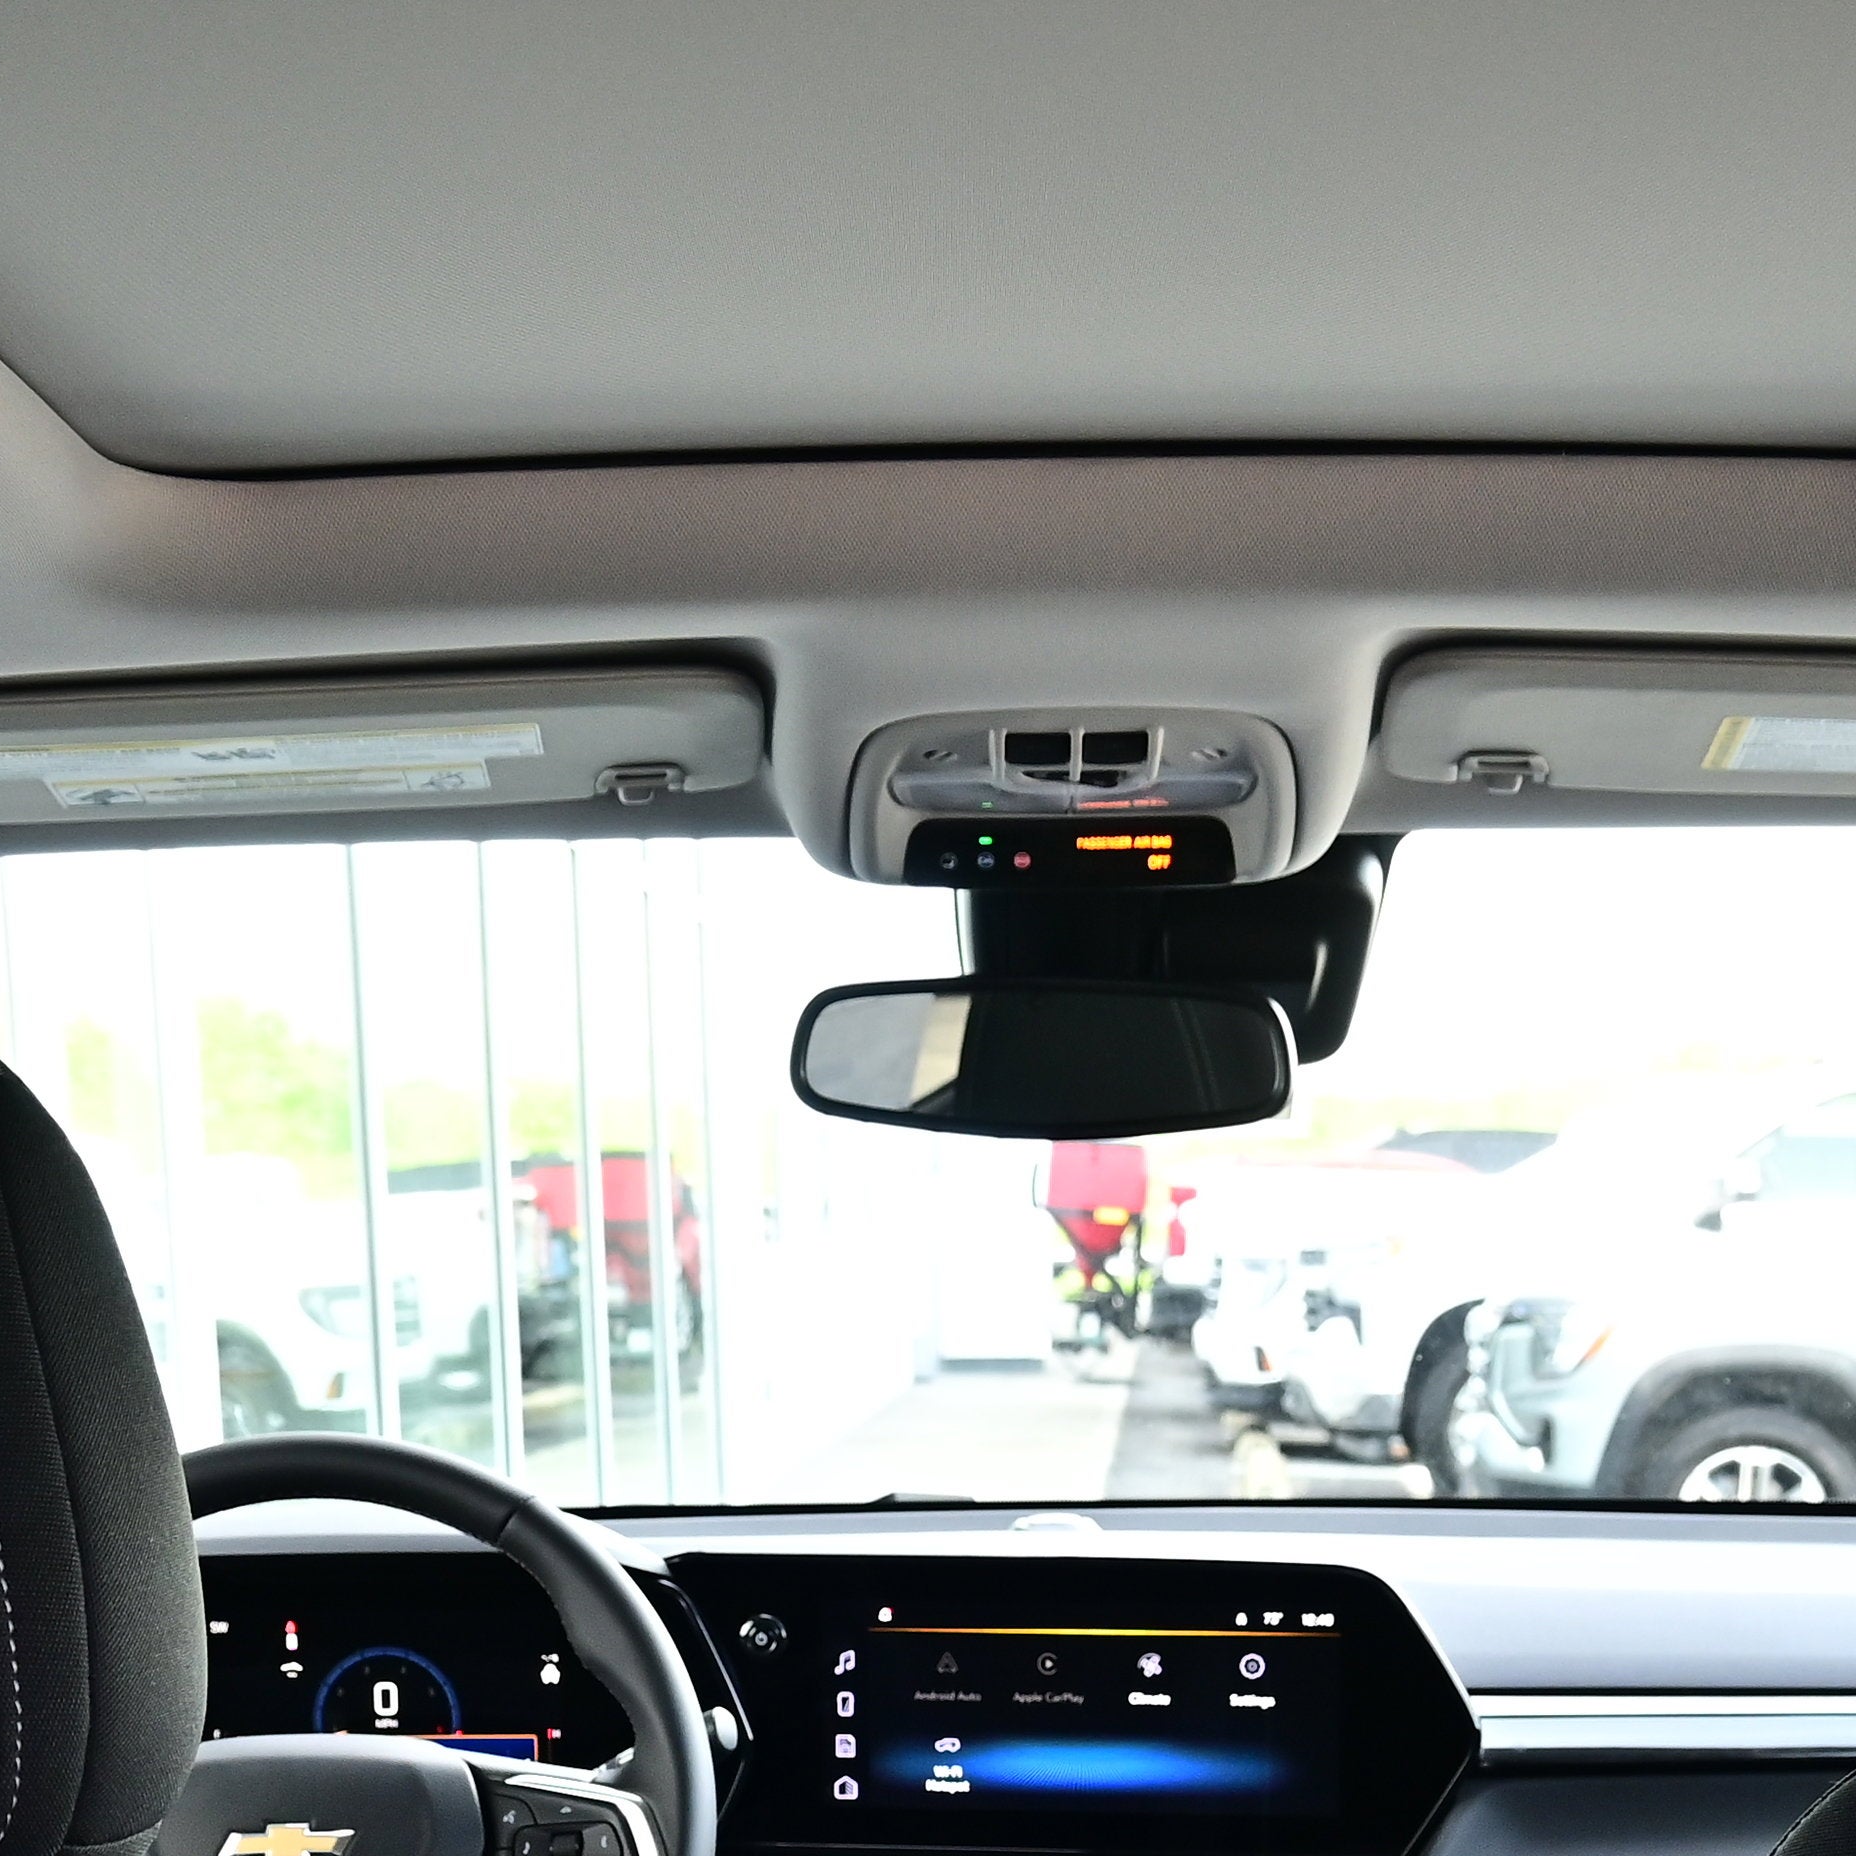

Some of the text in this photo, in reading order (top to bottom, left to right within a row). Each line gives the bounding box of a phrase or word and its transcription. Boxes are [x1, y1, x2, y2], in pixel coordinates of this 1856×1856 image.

[1076, 834, 1173, 851] PASSENGER AIR BAG
[1147, 853, 1171, 871] OFF
[209, 1620, 230, 1634] SW
[373, 1681, 399, 1717] 0
[914, 1690, 983, 1701] Android Auto
[1013, 1691, 1085, 1706] Apple CarPlay
[1127, 1691, 1172, 1706] Climate
[1229, 1693, 1276, 1710] Settings
[374, 1718, 399, 1729] MPH
